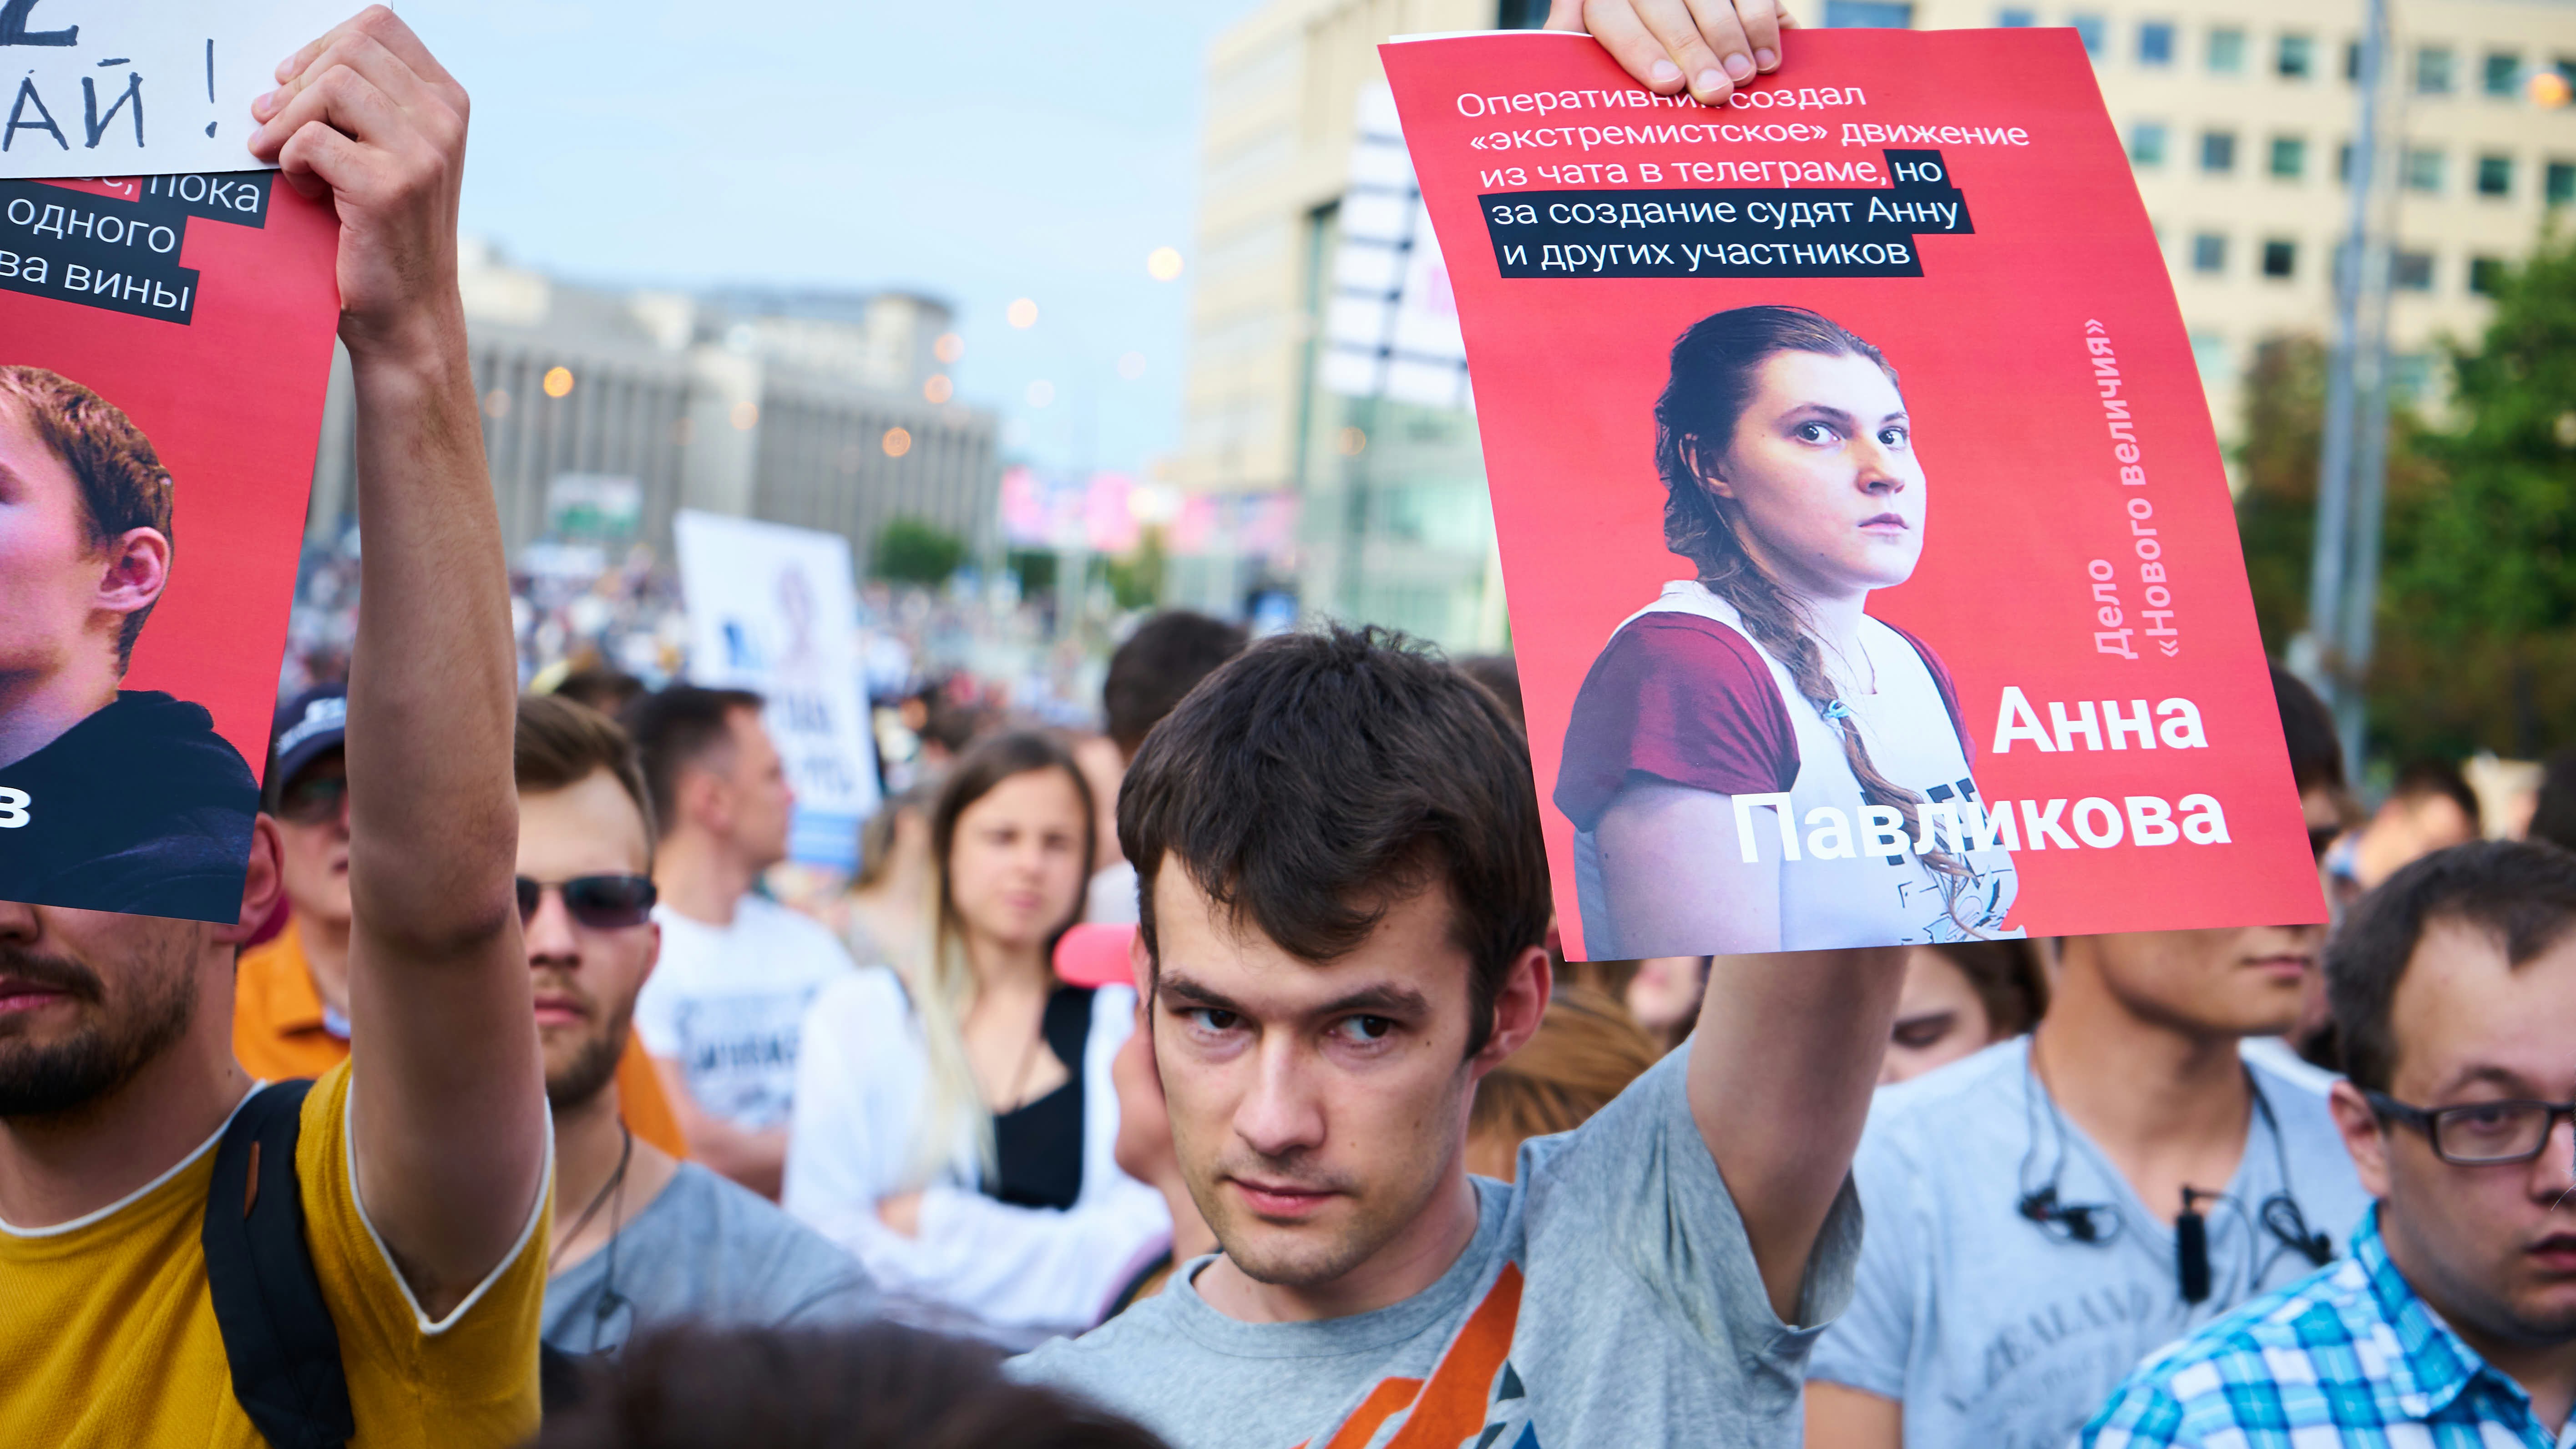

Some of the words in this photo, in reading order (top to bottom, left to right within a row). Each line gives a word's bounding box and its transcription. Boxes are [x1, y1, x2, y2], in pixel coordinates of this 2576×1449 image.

[1457, 90, 1721, 117] Оперативни
[1730, 87, 1866, 110] создал
[1470, 123, 1827, 151] «экстремистское»
[1841, 123, 2029, 147] движение
[1480, 167, 1528, 188] из
[1537, 164, 1629, 183] чата
[1639, 163, 1663, 182] в
[1670, 161, 1887, 188] телеграме,
[1894, 162, 1943, 182] но
[7, 198, 175, 253] одного
[1492, 204, 1539, 225] за
[1549, 201, 1737, 228] создание
[1747, 201, 1854, 230] судят
[1868, 196, 1958, 229] Анну
[1503, 245, 1528, 265] и
[1541, 244, 1675, 272] других
[1681, 243, 1911, 272] участников
[64, 263, 189, 311] вины
[2085, 319, 2146, 486] величия»
[2126, 497, 2179, 659] «Нового
[2088, 559, 2138, 659] Дело
[1992, 686, 2209, 754] Анна
[1731, 791, 2232, 863] Павликова
